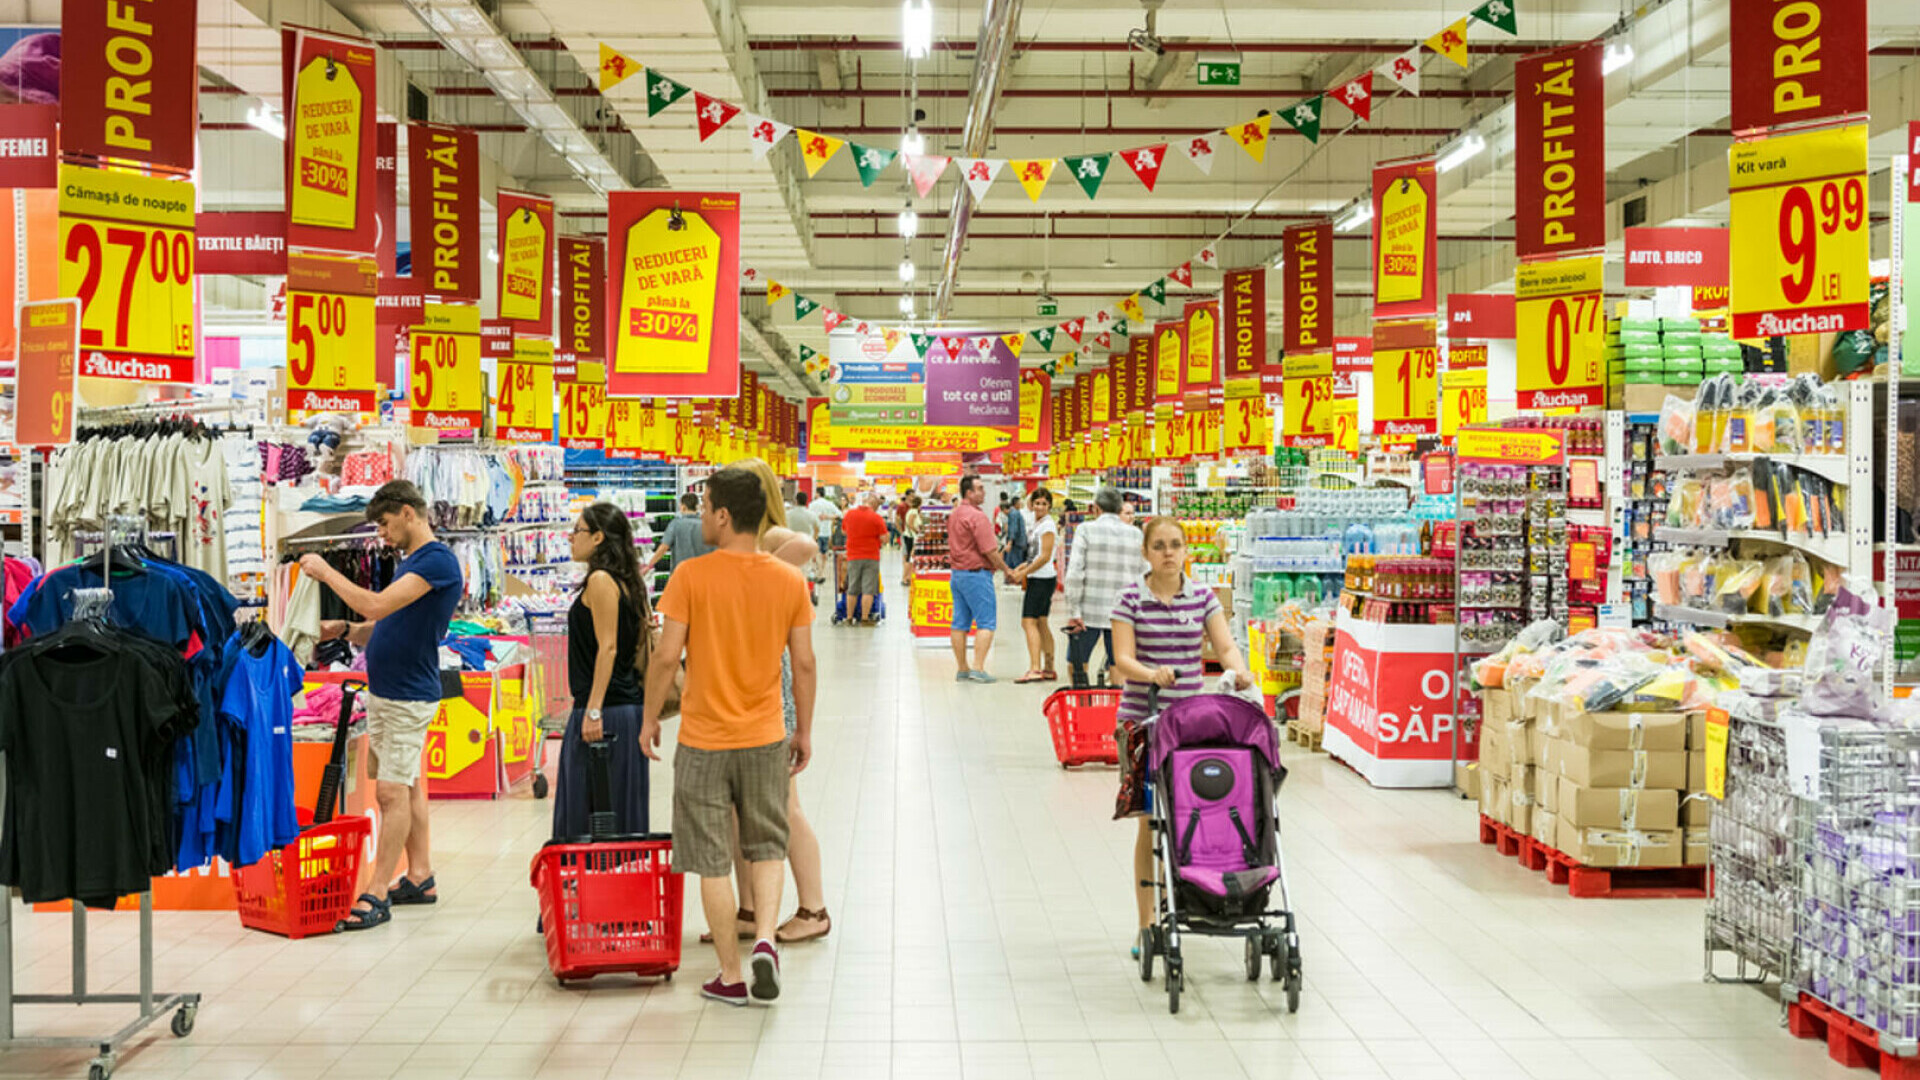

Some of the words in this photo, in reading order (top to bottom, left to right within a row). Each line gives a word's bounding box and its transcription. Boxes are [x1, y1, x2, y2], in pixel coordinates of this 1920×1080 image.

[1772, 0, 1821, 114] PRO
[301, 99, 354, 119] REDUCERI
[306, 124, 320, 139] DE
[1534, 58, 1575, 245] PROFITĂ!
[1736, 162, 1754, 175] Kit
[1759, 157, 1787, 171] vară
[303, 161, 347, 191] -30%
[124, 193, 140, 207] de
[142, 196, 187, 213] noapte
[426, 134, 459, 290] PROFITĂ!
[198, 237, 242, 251] TEXTILE
[633, 246, 708, 271] REDUCERI
[1665, 250, 1703, 264] BRICO
[638, 275, 656, 291] DE
[660, 267, 703, 287] VARĂ
[1295, 231, 1318, 345] PROFITĂ!
[1519, 276, 1539, 288] Bere
[1541, 275, 1557, 285] non
[1560, 272, 1586, 283] alcool
[1822, 273, 1840, 302] LEI
[400, 295, 421, 308] FETE
[570, 243, 591, 352] PROFITĂ!
[647, 295, 677, 308] până
[679, 297, 690, 309] la
[632, 312, 696, 337] -30%
[1234, 273, 1252, 371] PROFITĂ!
[1757, 313, 1844, 336] Auchan
[85, 352, 171, 380] Auchan
[931, 355, 943, 364] ce
[980, 376, 1012, 389] Oferim
[304, 391, 360, 411] Auchan
[943, 389, 963, 402] tot
[964, 391, 978, 402] ce
[981, 391, 989, 402] e
[992, 389, 1012, 402] util
[1532, 391, 1589, 408] Auchan
[424, 413, 470, 427] Auchan
[1385, 421, 1426, 434] Auchan
[506, 427, 543, 441] Auchan
[850, 427, 919, 436] REDUCERI
[907, 436, 977, 450] -30%
[928, 604, 953, 622] -30
